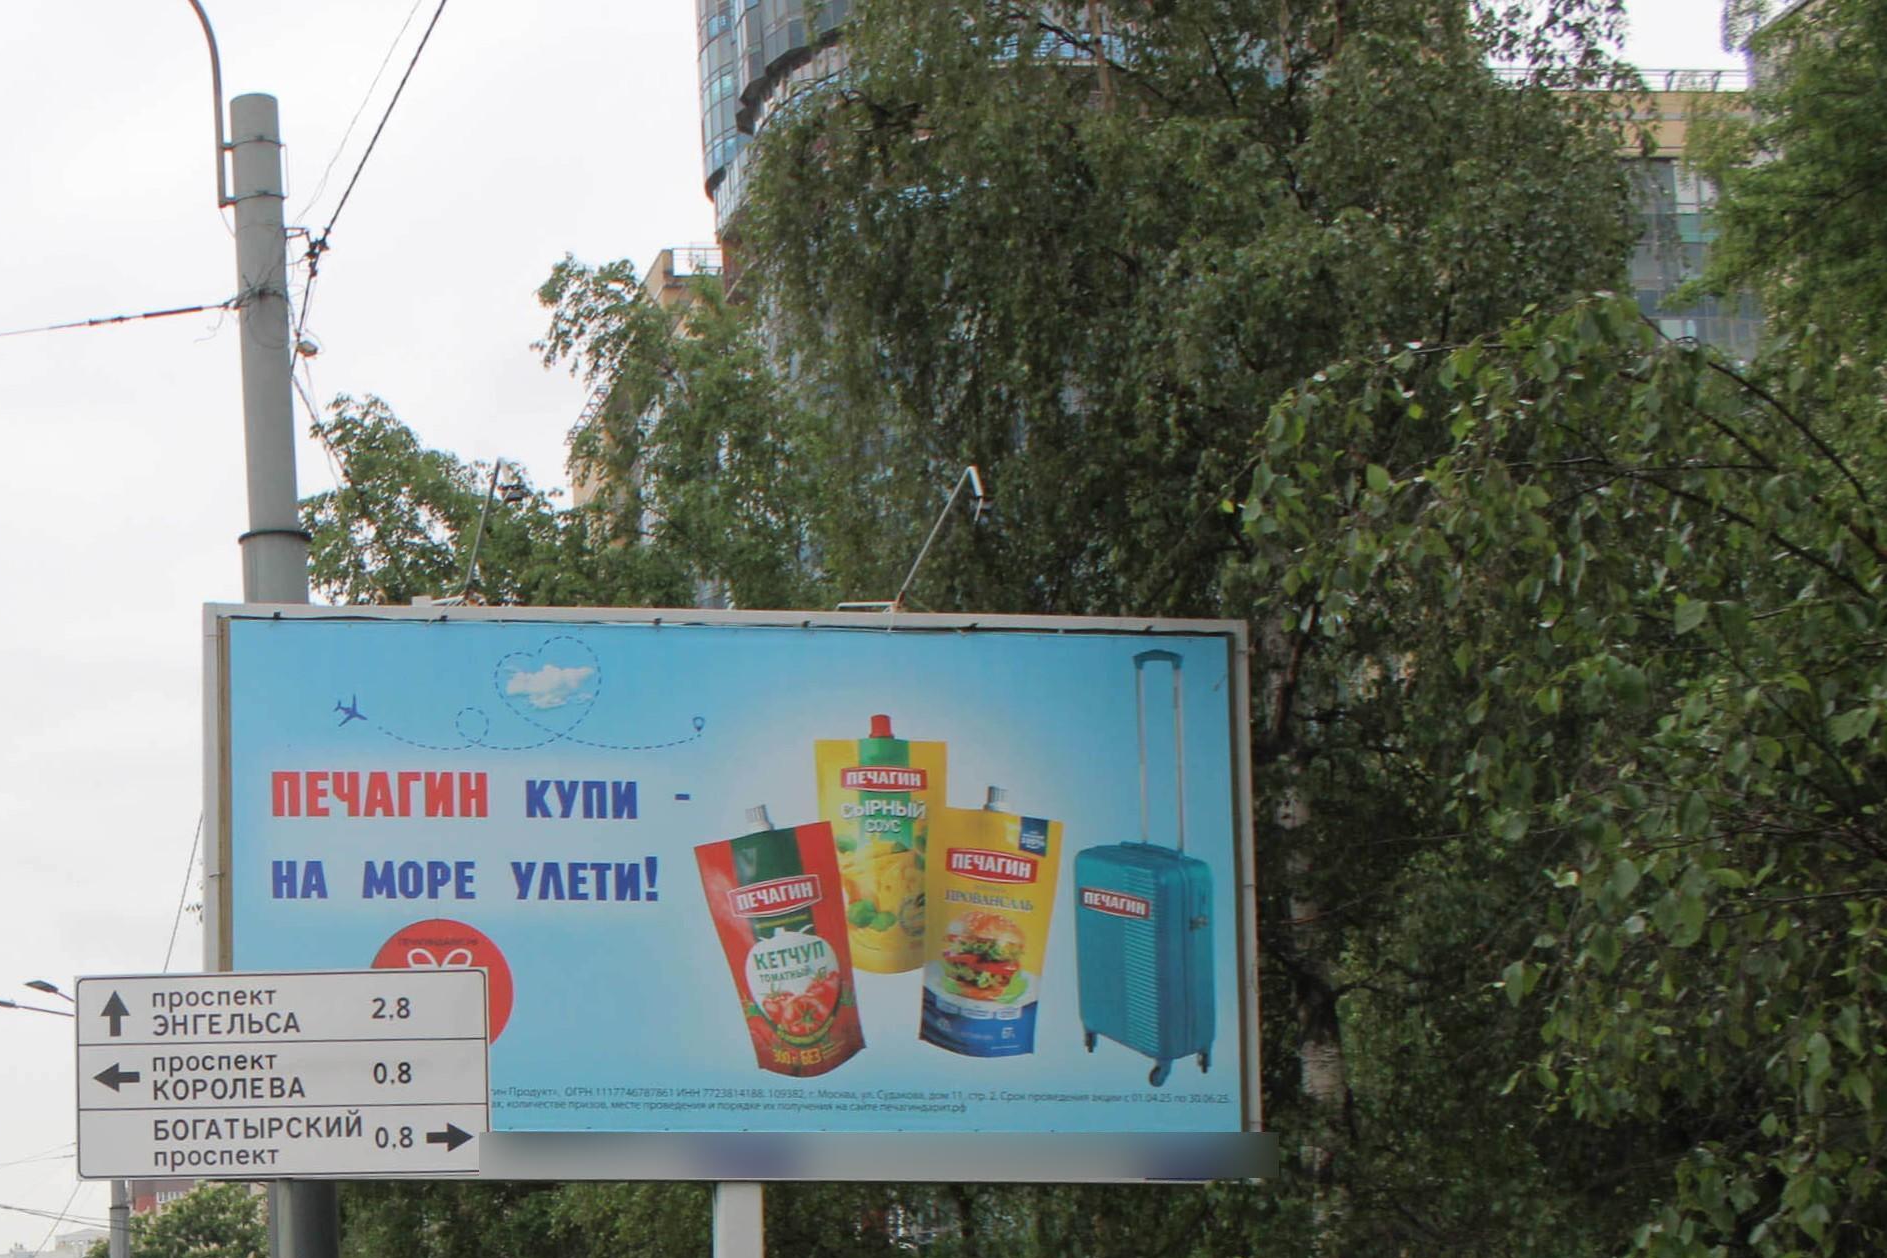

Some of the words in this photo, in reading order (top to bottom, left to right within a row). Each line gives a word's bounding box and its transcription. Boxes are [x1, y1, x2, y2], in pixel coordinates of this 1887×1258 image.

[846, 770, 921, 787] ПЕЧАГИН
[271, 771, 489, 819] ПЕЧАГИН
[525, 779, 638, 820] КУПИ
[840, 799, 927, 820] СЫРНЫЙ
[864, 819, 902, 833] СОУС
[951, 852, 1031, 879] ПЕЧАГИН
[271, 860, 329, 900] НА
[362, 860, 476, 900] МОРЕ
[510, 856, 659, 902] УЛЕТИ!
[736, 881, 814, 911] ПЕЧАГИН
[1083, 891, 1146, 916] ПЕЧАГИН
[753, 940, 825, 970] КЕТЧУП
[759, 965, 814, 983] ТОМАТНЫЙ
[151, 989, 277, 1013] проспект
[152, 1012, 301, 1036] ЭНГЕЛЬСА
[152, 1054, 278, 1077] проспект
[153, 1077, 306, 1101] КОРОЛЕВА
[154, 1109, 363, 1141] БОГАТЫРСКИЙ
[154, 1149, 280, 1172] проспект
